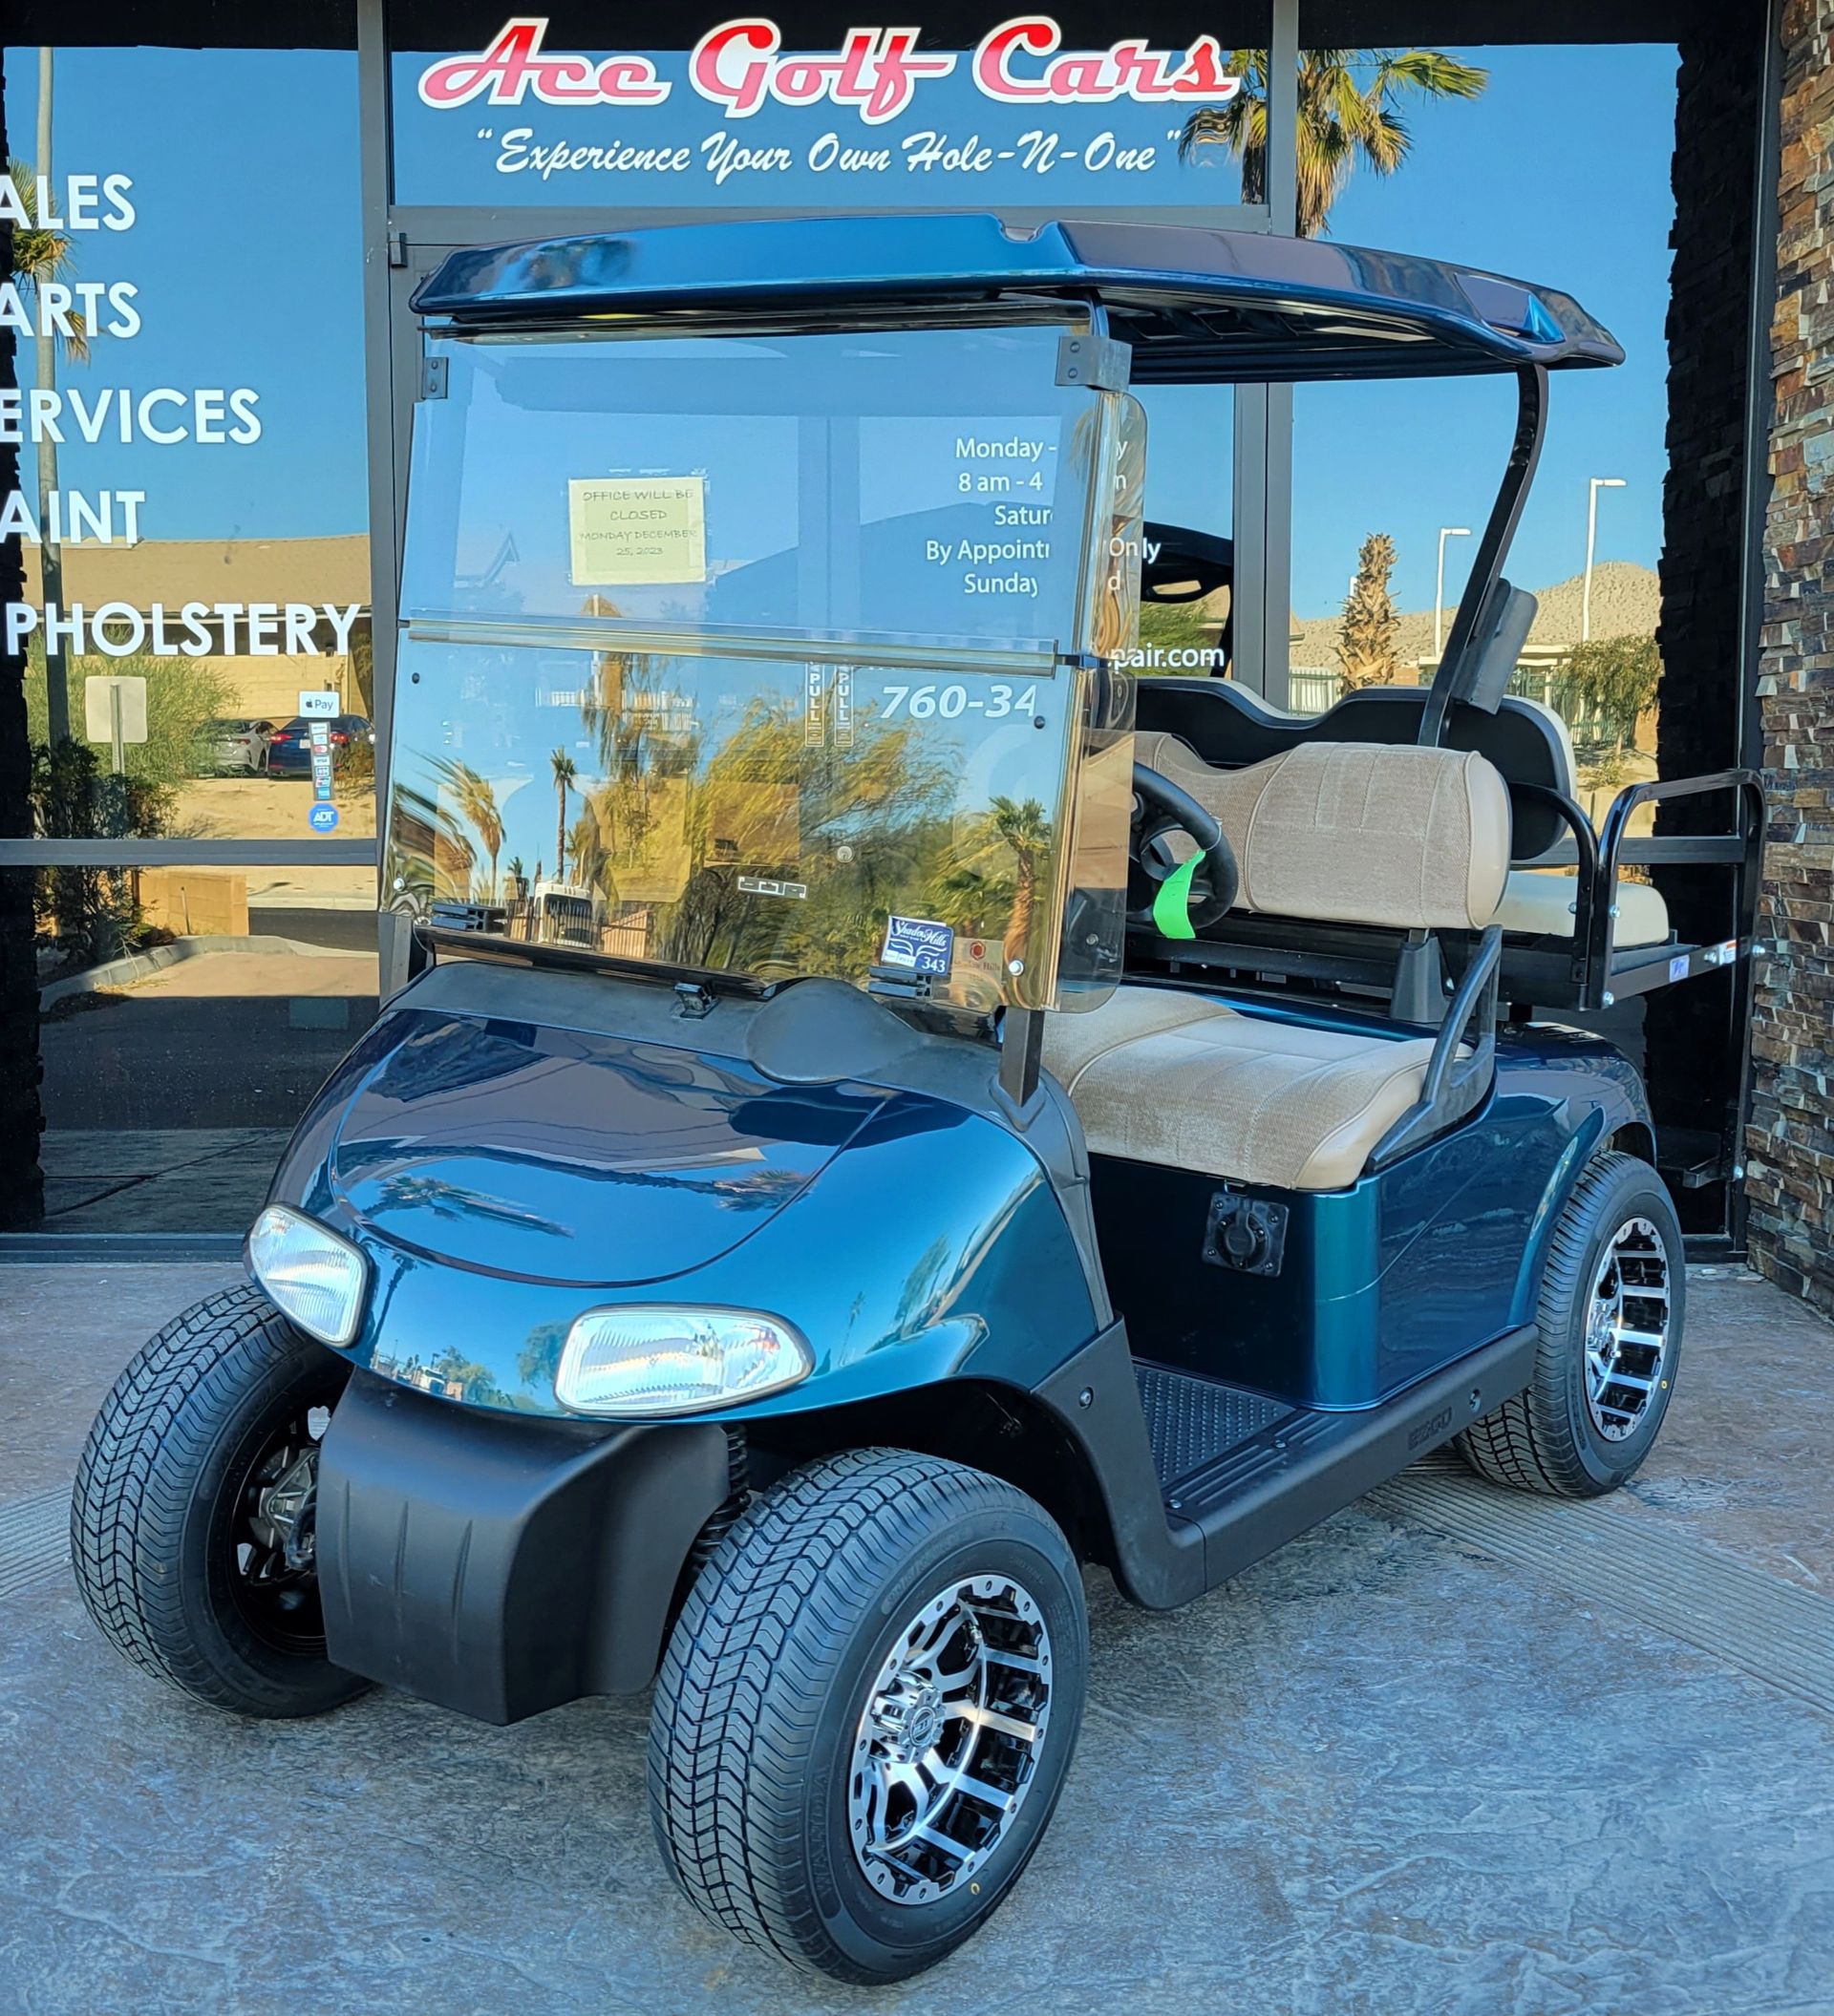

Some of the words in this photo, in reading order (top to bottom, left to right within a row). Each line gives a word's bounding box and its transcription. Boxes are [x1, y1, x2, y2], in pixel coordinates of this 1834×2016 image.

[418, 17, 672, 109] Ace
[689, 17, 957, 126] Golf
[971, 15, 1241, 106] Cars
[701, 133, 791, 184] Your
[808, 135, 890, 172] Own
[955, 435, 1044, 463] Monday
[958, 472, 971, 492] 8
[977, 477, 1010, 492] am
[1029, 471, 1043, 491] 4
[583, 491, 631, 502] OFFICE
[634, 490, 672, 500] WILL
[674, 489, 694, 499] BE
[609, 510, 668, 521] CLOSED
[994, 505, 1053, 525] Satur
[580, 531, 632, 542] MONDAY
[634, 529, 698, 541] DECEMBER
[927, 540, 952, 565] By
[957, 539, 1051, 565] Appoint
[1109, 537, 1162, 564] Only
[6, 601, 361, 657] PHOLSTERY
[314, 699, 333, 711] Pay
[809, 672, 821, 722] PULL
[838, 672, 850, 721] PULL
[313, 811, 334, 822] ADT
[922, 956, 946, 972] 343
